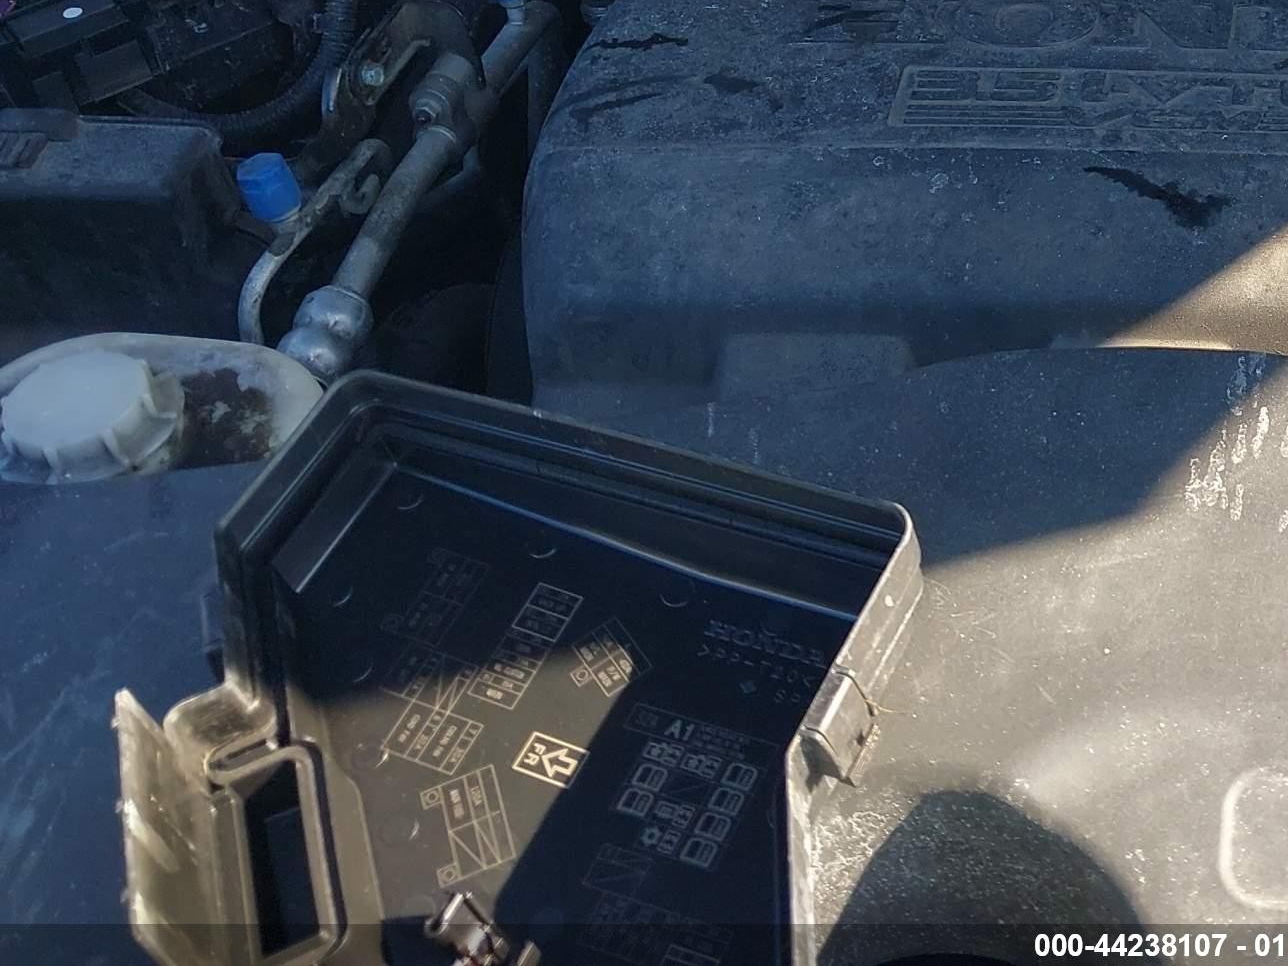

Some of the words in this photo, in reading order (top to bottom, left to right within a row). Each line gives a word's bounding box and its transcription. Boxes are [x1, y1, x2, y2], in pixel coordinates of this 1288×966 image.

[703, 619, 828, 670] HONDA
[664, 717, 696, 741] A1
[522, 742, 547, 767] FR
